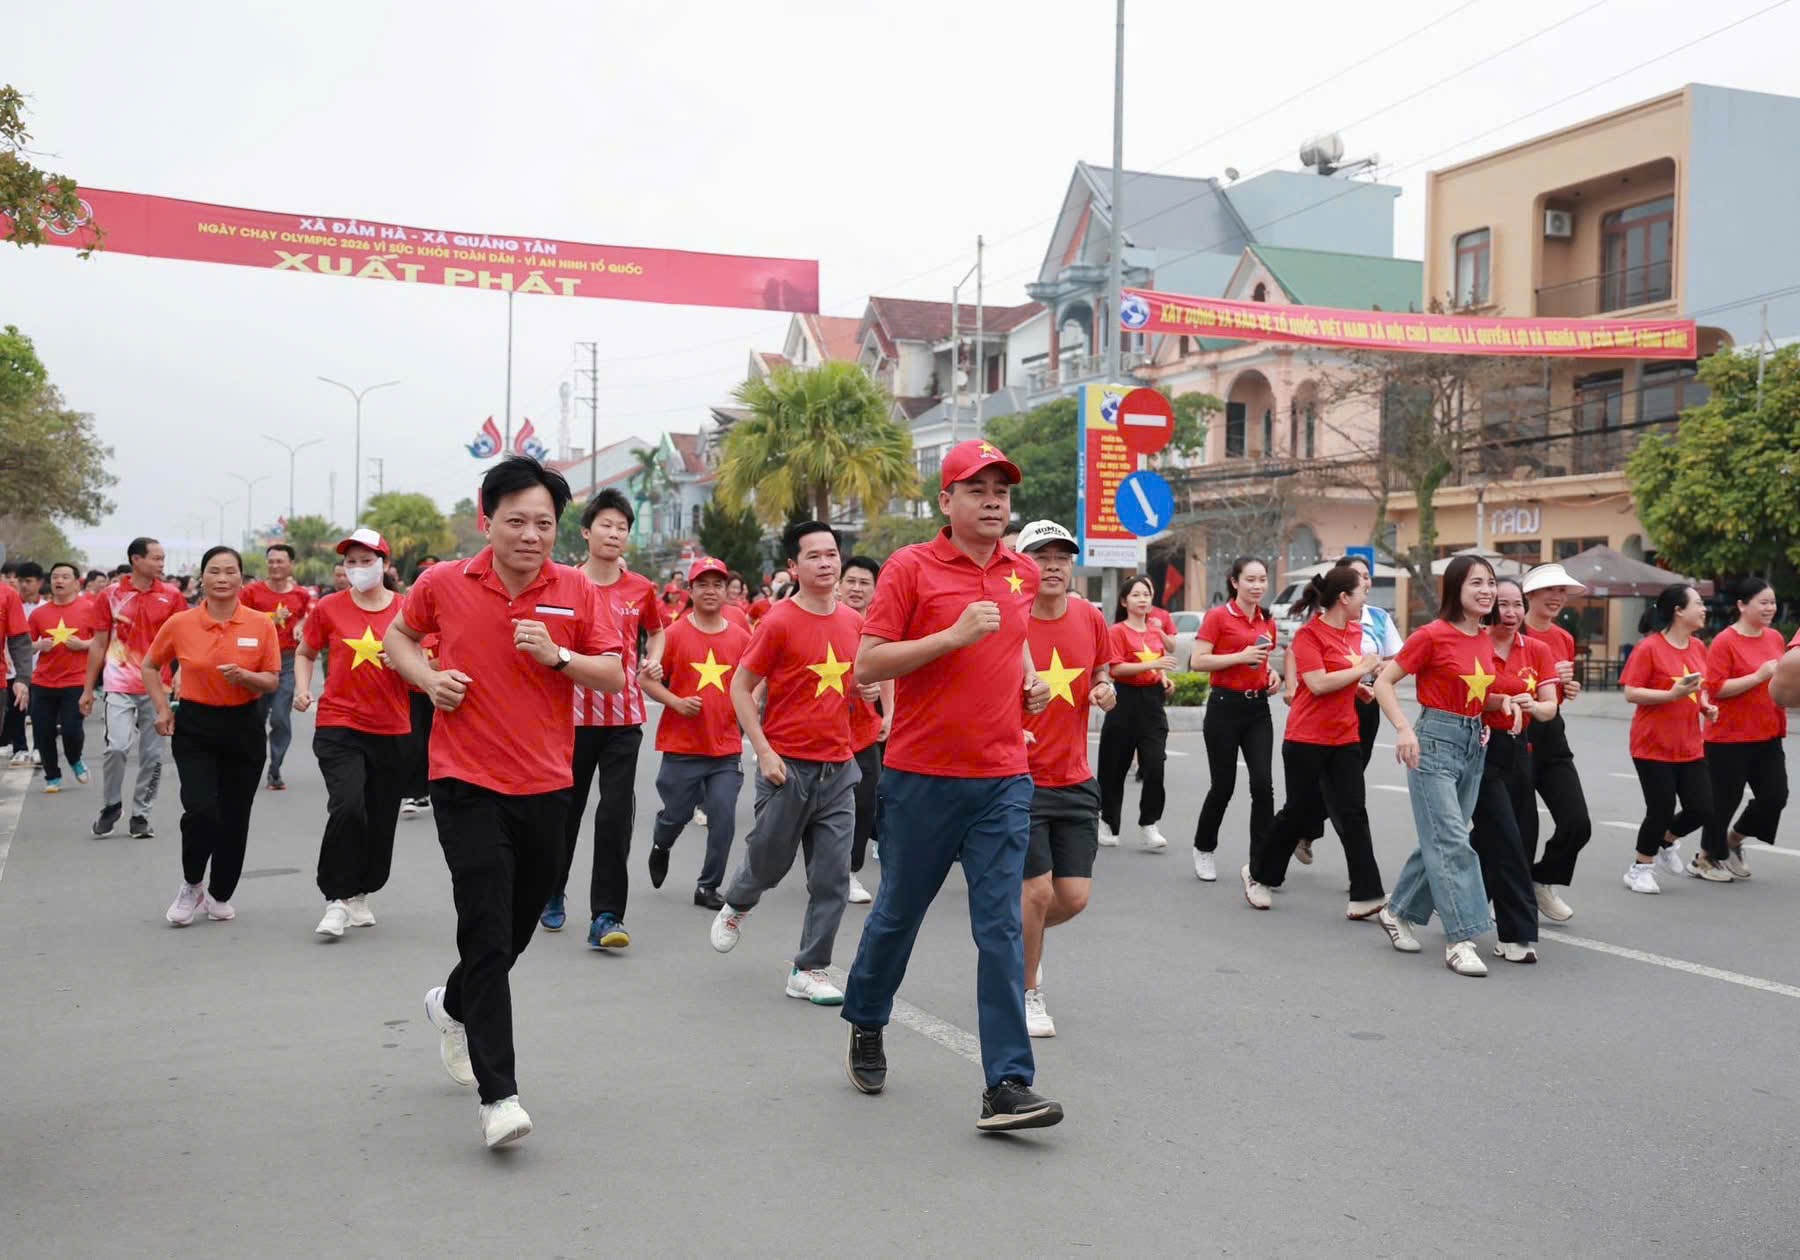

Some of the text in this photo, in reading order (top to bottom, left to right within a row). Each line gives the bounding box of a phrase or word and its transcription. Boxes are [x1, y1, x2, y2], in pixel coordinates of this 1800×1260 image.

[198, 222, 237, 236] NGÀY
[240, 228, 278, 243] CHẠY
[281, 232, 338, 247] OLYMPIC
[340, 239, 371, 250] 2026
[374, 238, 388, 253] VÌ
[388, 238, 414, 255] SỨC
[453, 247, 487, 262] TOÀN
[489, 251, 515, 265] DÂN
[524, 253, 537, 267] VÌ
[539, 256, 556, 268] AN
[558, 259, 588, 271] NINH
[590, 257, 605, 273] TỔ
[608, 261, 644, 276] QUỐC
[300, 217, 327, 232] XÃ
[380, 227, 407, 241] HÀ
[422, 232, 449, 245] XÃ
[453, 235, 519, 251] QUẢNG
[523, 240, 557, 255] TÂN
[272, 249, 582, 297] XUẤT PHÁT
[1160, 302, 1183, 324] XÂY
[1319, 317, 1342, 340] VIỆT
